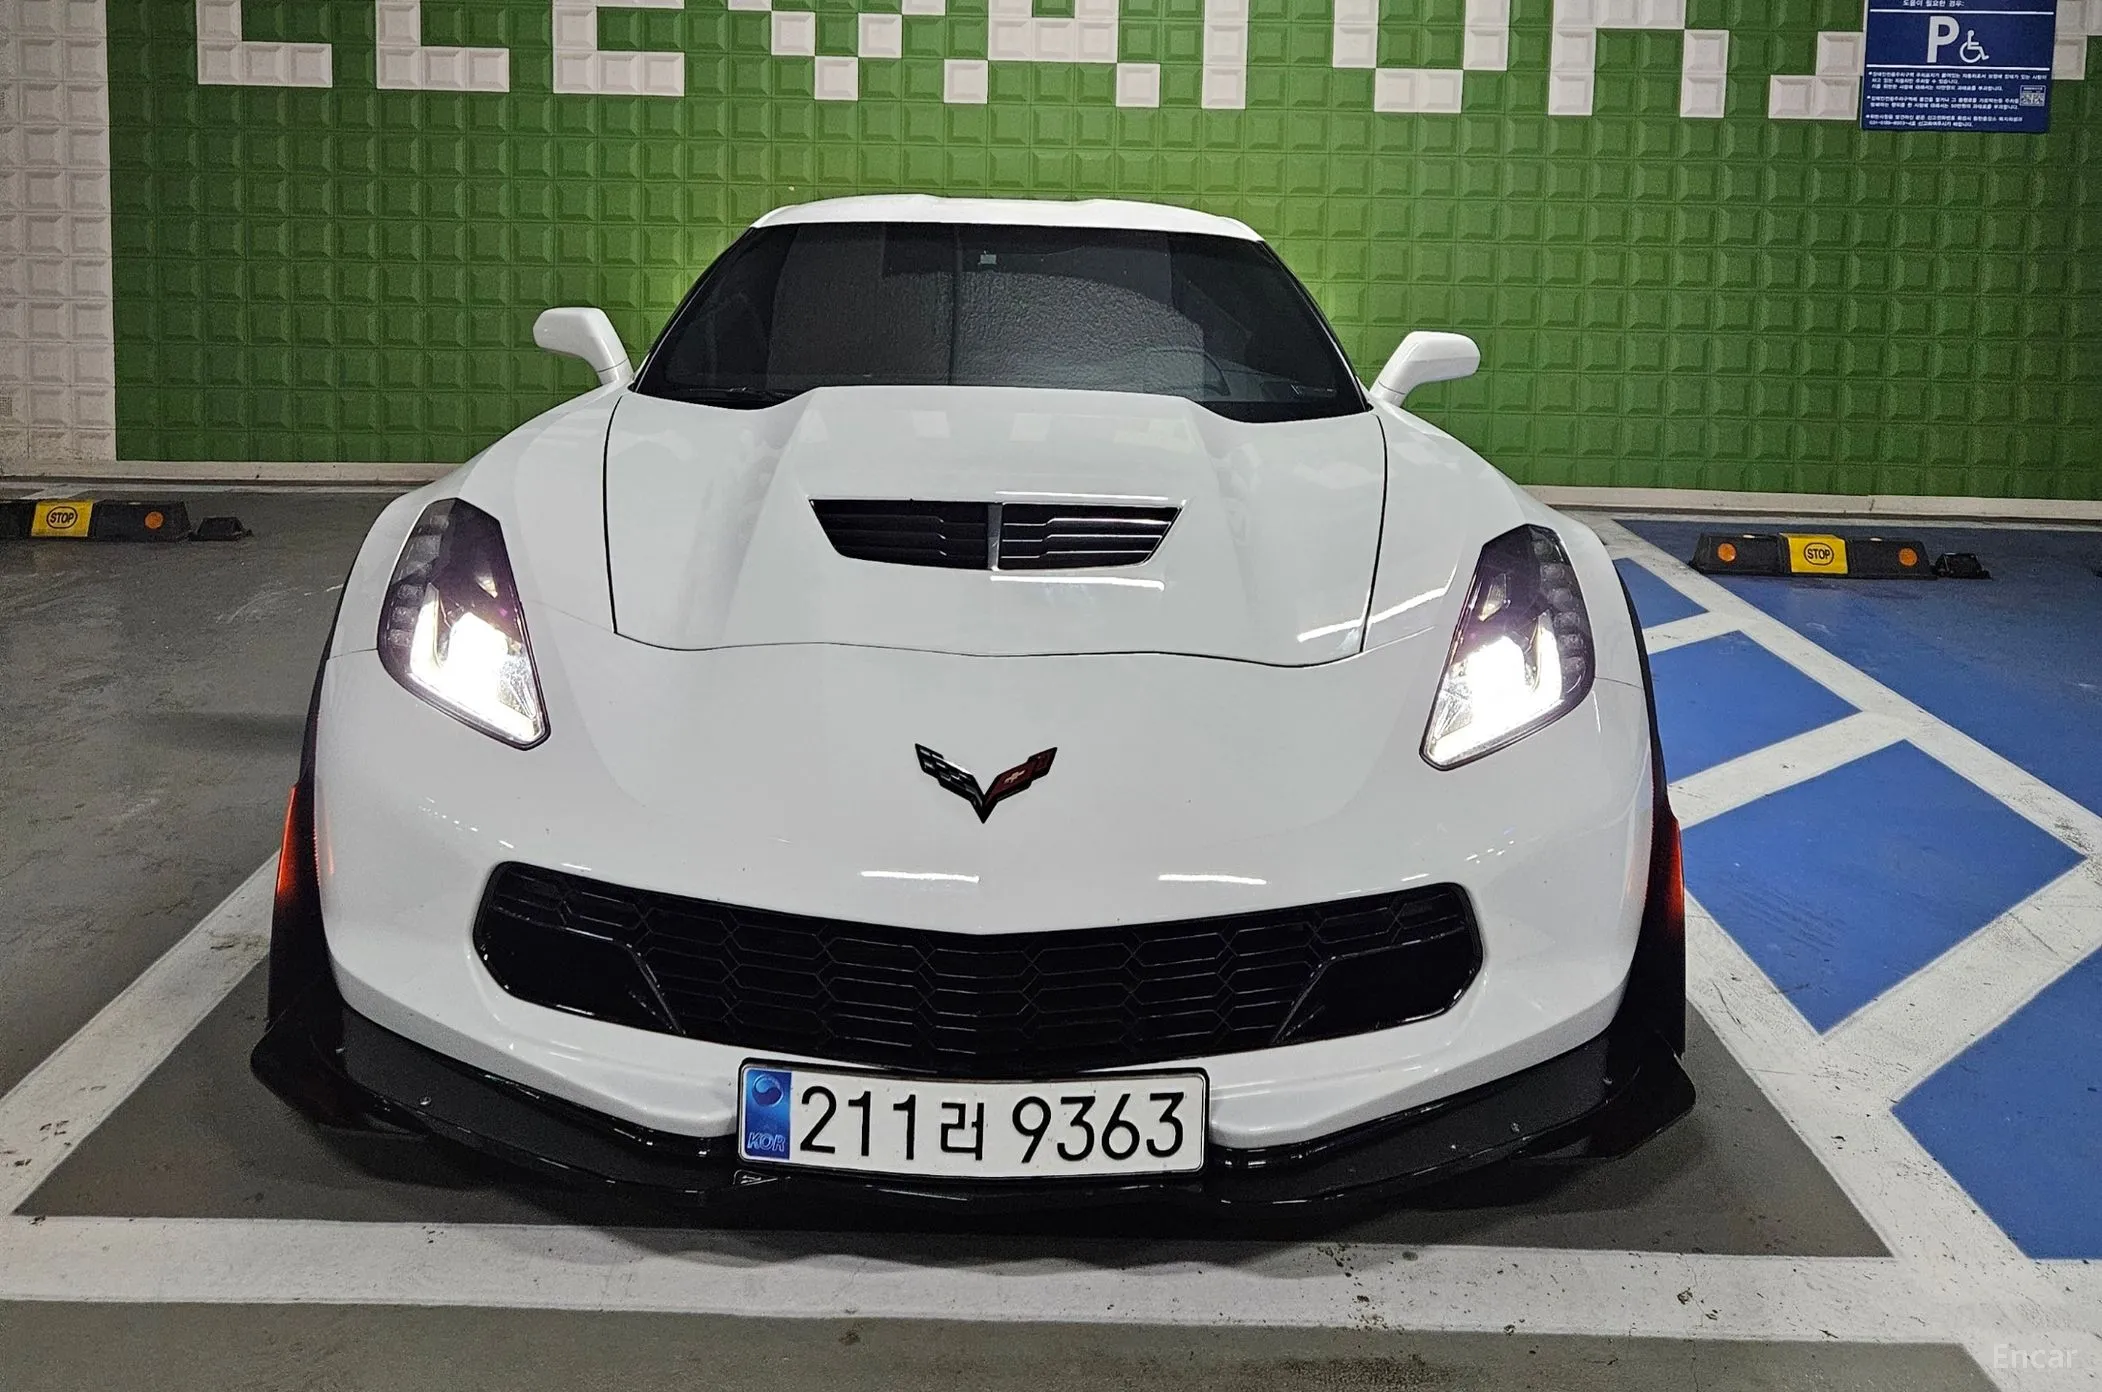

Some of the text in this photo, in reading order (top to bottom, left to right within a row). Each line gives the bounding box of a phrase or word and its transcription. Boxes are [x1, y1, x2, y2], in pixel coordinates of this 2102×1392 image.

[1926, 15, 1960, 63] P
[49, 511, 75, 523] STOP
[1806, 548, 1831, 560] STOP
[799, 1085, 1186, 1164] 211러 9363
[746, 1131, 786, 1153] KOR
